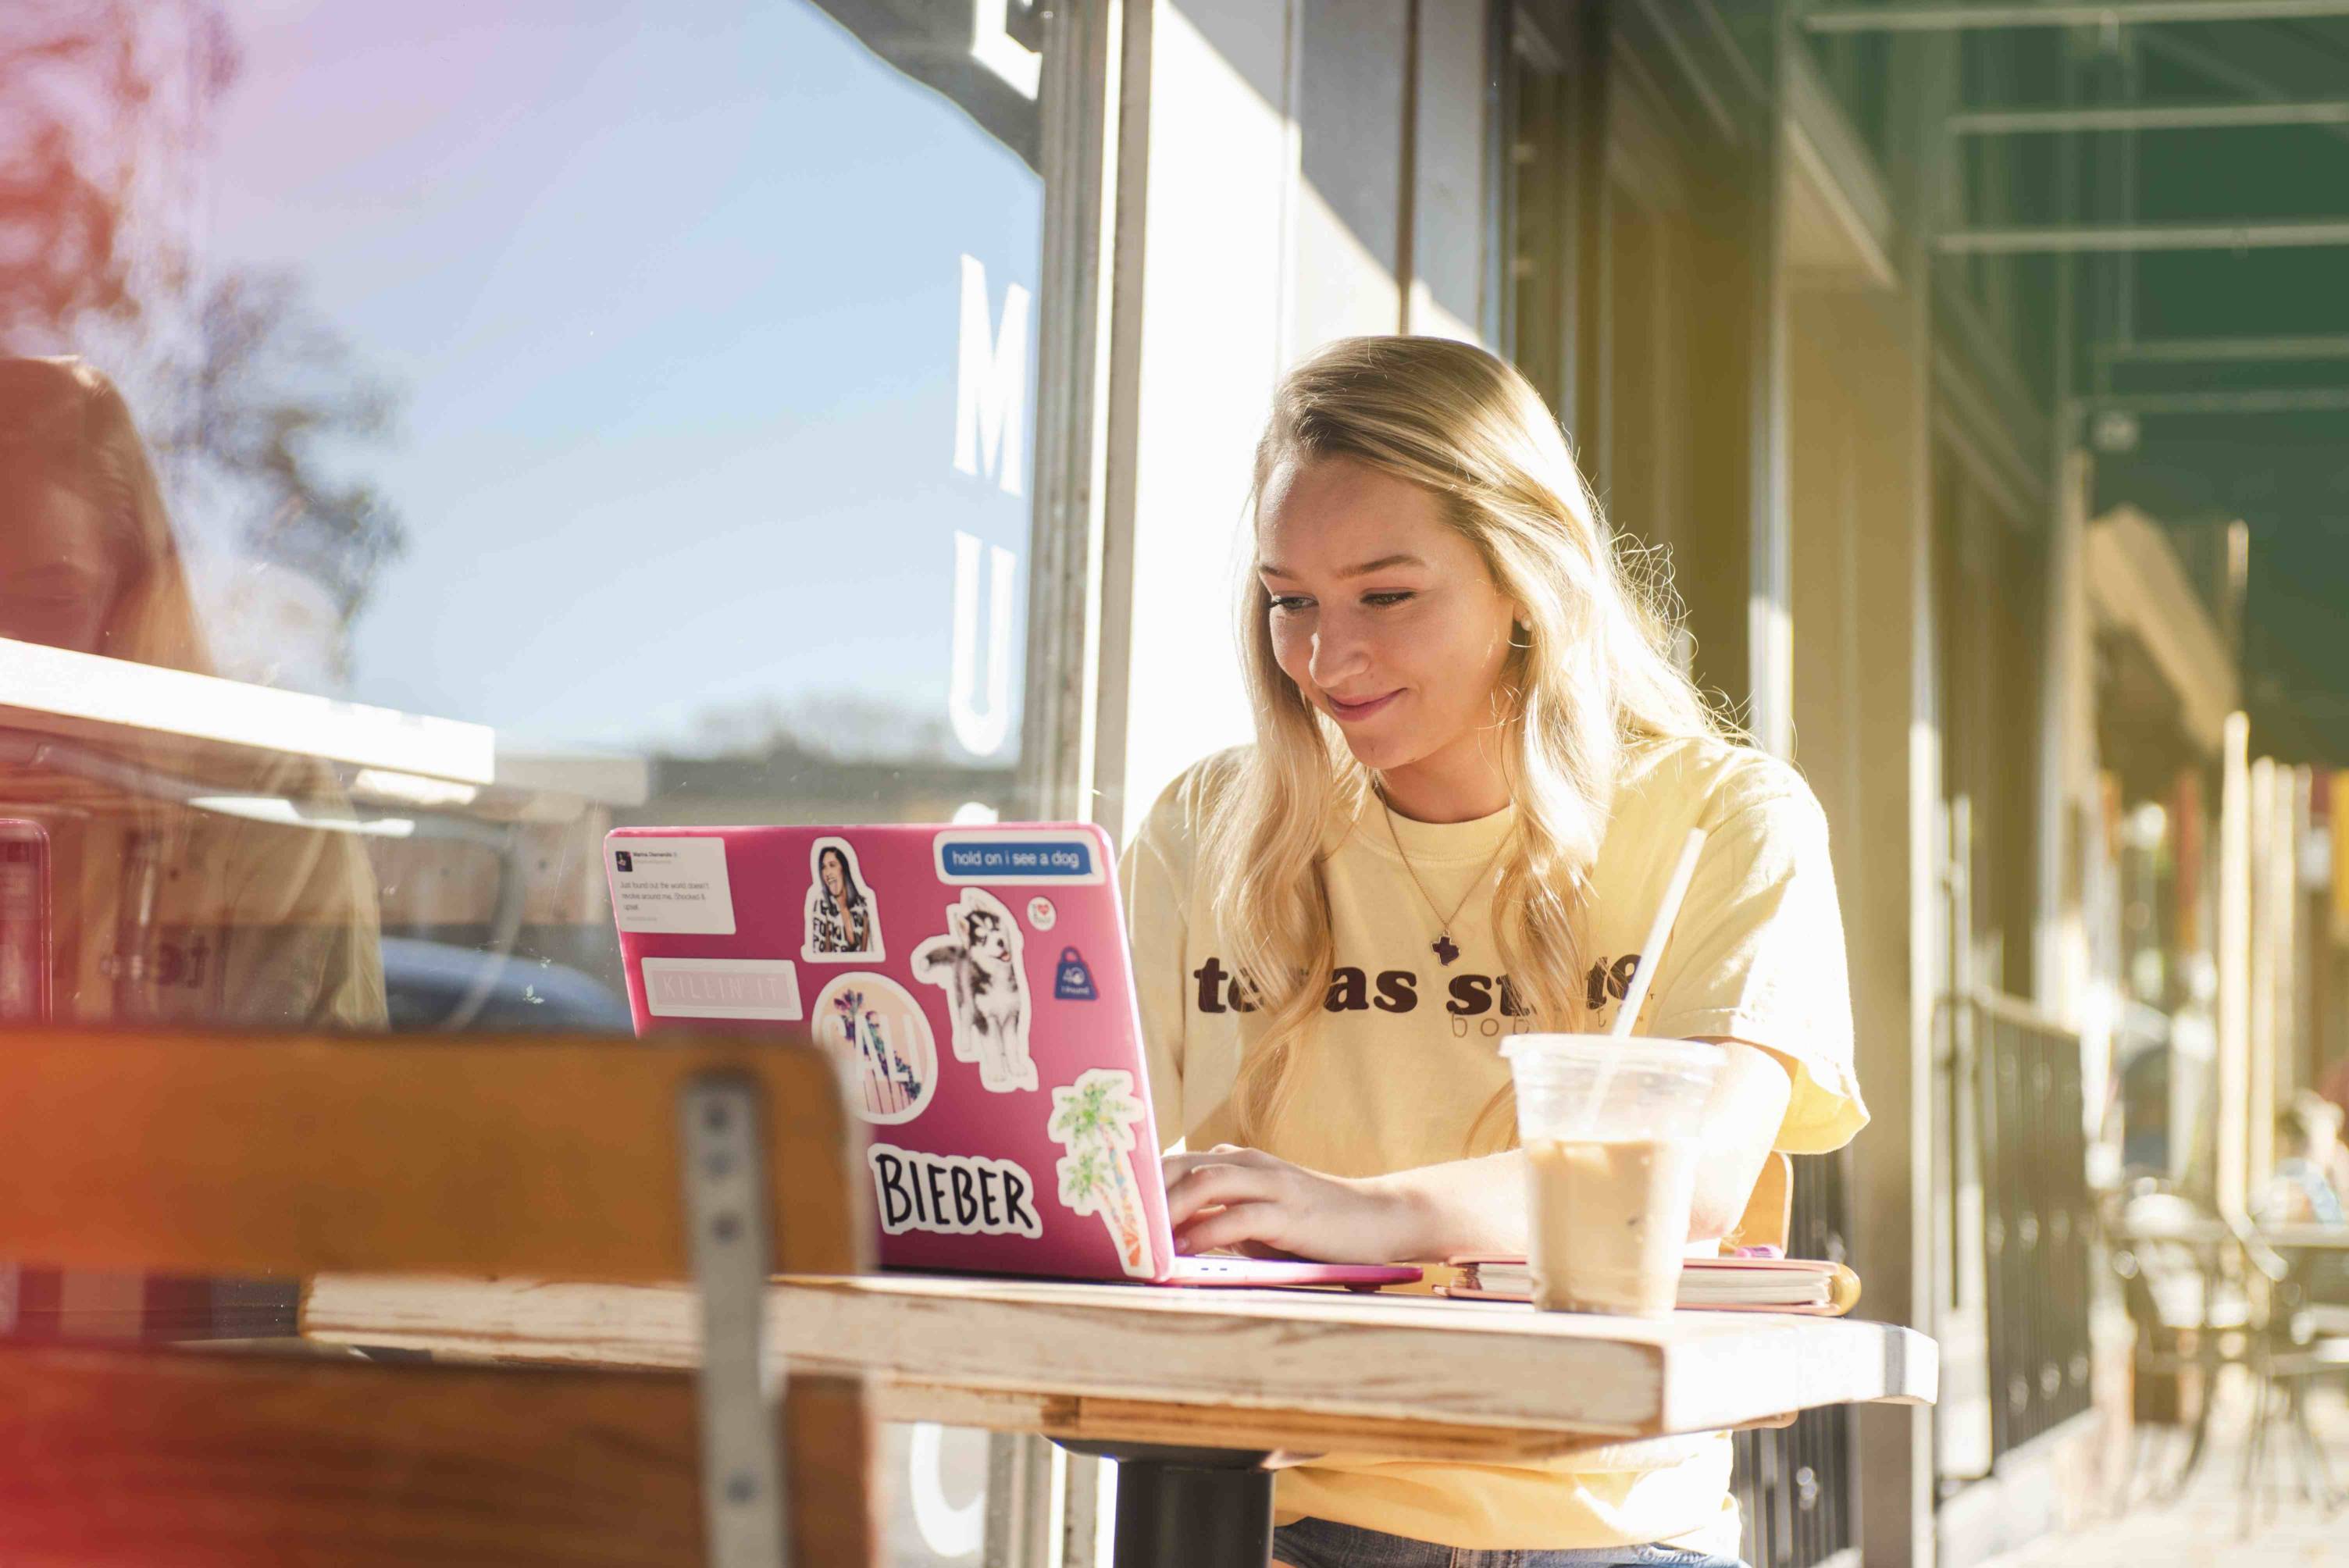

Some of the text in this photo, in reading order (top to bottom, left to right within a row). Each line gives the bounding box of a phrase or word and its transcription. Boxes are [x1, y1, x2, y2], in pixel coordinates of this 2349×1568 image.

[952, 850, 1080, 869] hold on i see a dog
[756, 977, 778, 1000] IT
[1193, 957, 1418, 1014] teas
[875, 1153, 1034, 1229] BIEBER
